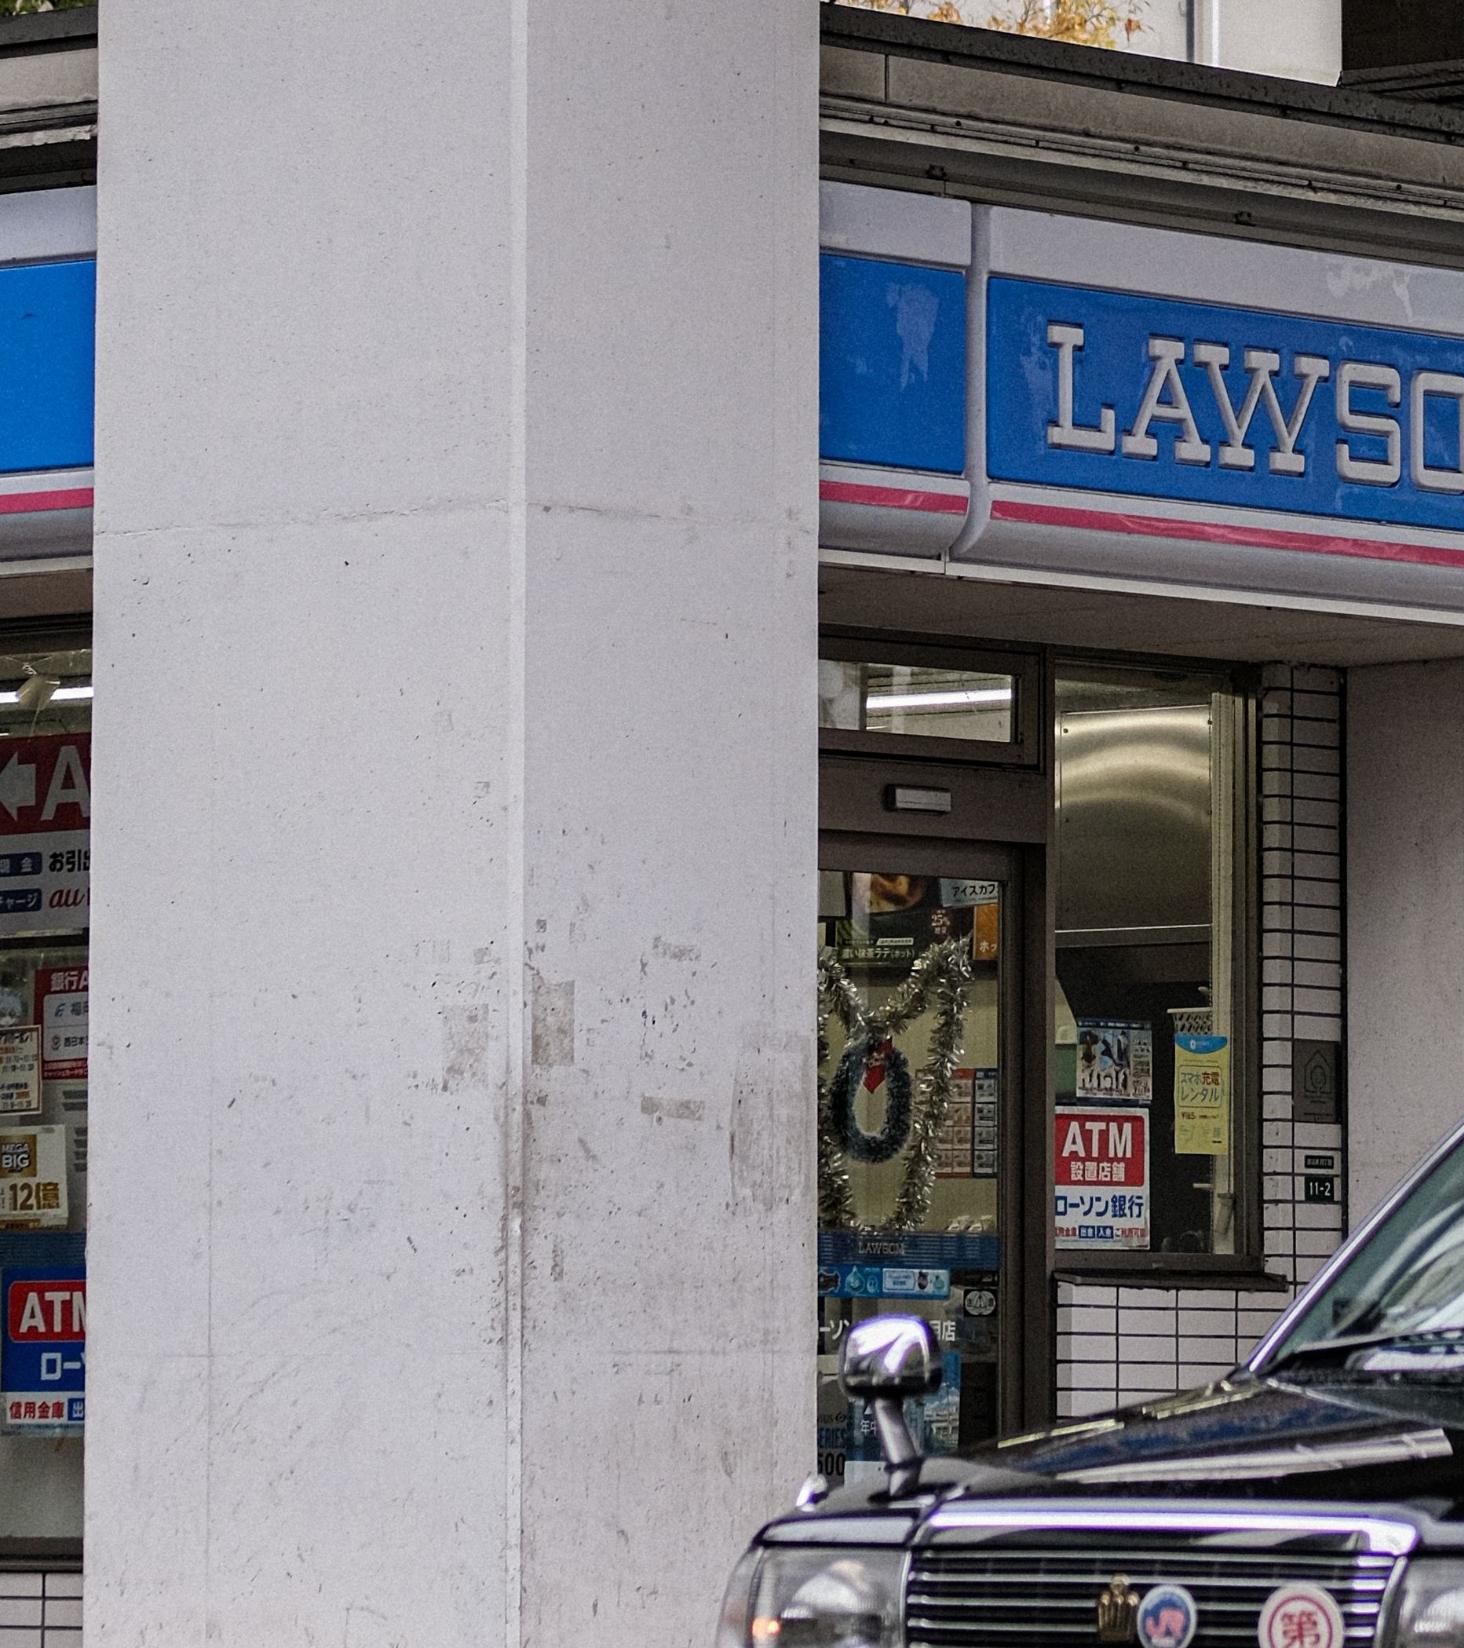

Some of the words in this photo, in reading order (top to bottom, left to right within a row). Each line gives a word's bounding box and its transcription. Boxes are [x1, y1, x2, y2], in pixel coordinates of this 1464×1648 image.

[49, 888, 85, 908] au
[1181, 1086, 1219, 1103] レンタル
[1062, 1121, 1132, 1159] ATM
[3, 1154, 30, 1168] BIG
[1070, 1161, 1125, 1182] 設置店舗
[1309, 1182, 1331, 1197] 11-2
[1055, 1194, 1145, 1218] ローソン銀行
[9, 1401, 65, 1419] 信用金庫
[1281, 1609, 1321, 1648] 第
